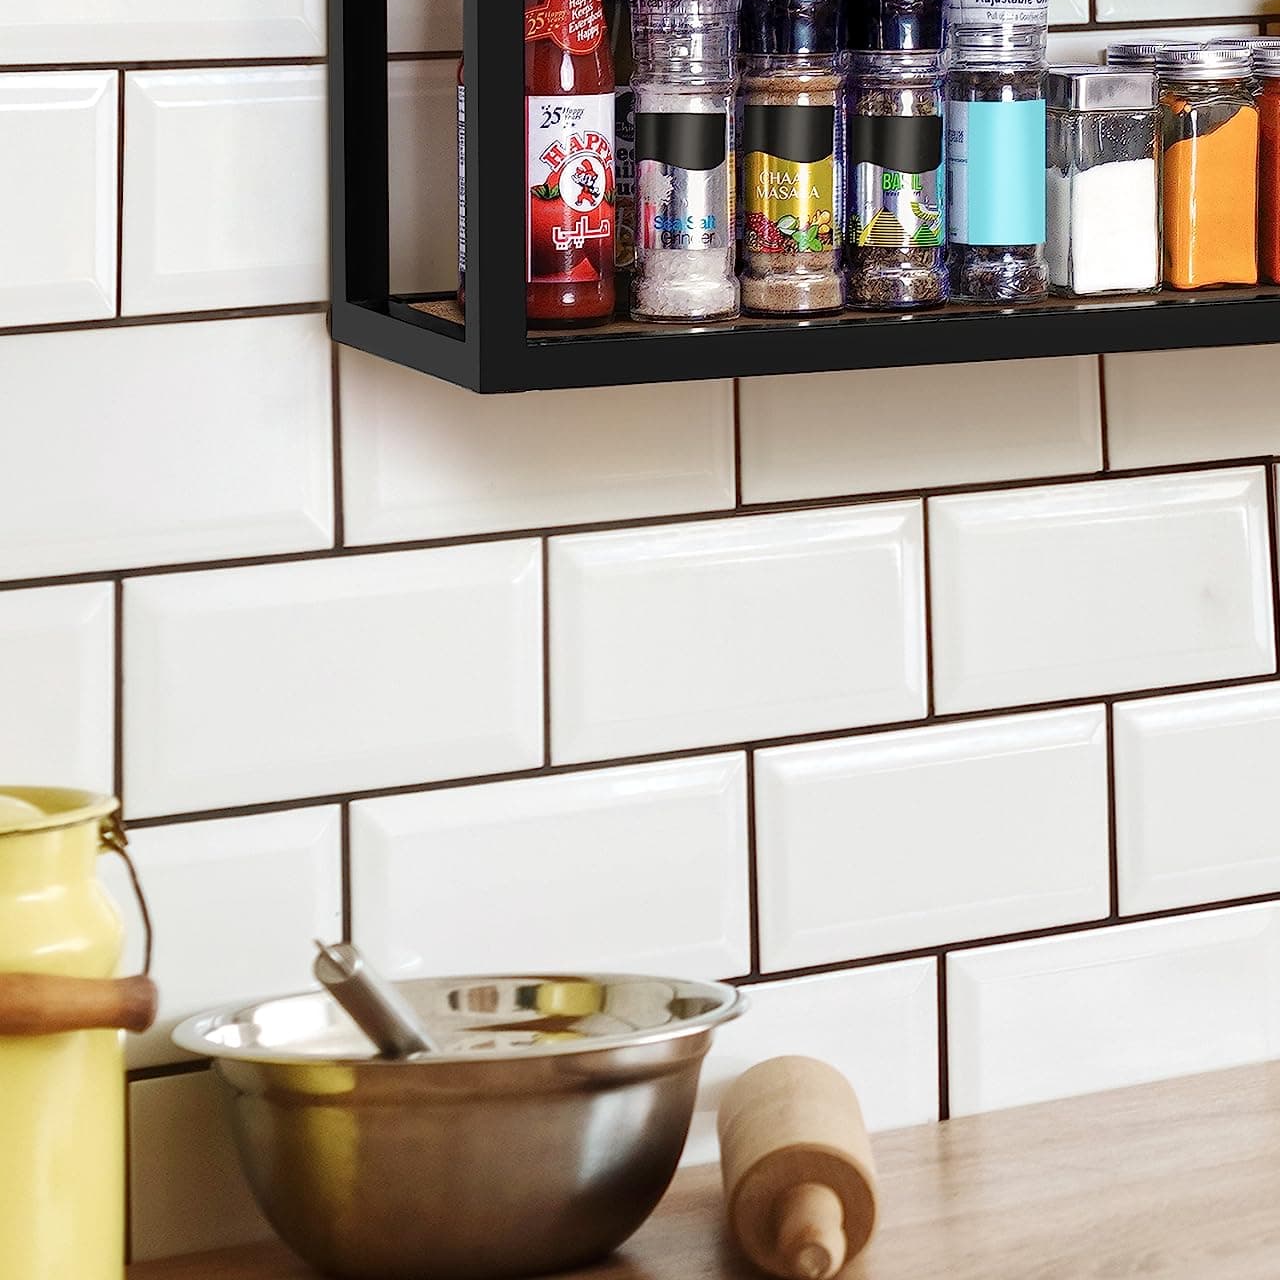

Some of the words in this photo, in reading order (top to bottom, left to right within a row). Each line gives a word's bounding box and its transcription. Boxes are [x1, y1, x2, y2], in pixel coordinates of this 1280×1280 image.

[572, 3, 593, 20] Keeps
[527, 11, 545, 37] 25
[577, 24, 600, 42] Happy
[539, 106, 563, 129] 25
[540, 131, 616, 171] HAPPY
[756, 185, 820, 200] MASAA
[654, 215, 683, 230] Sea
